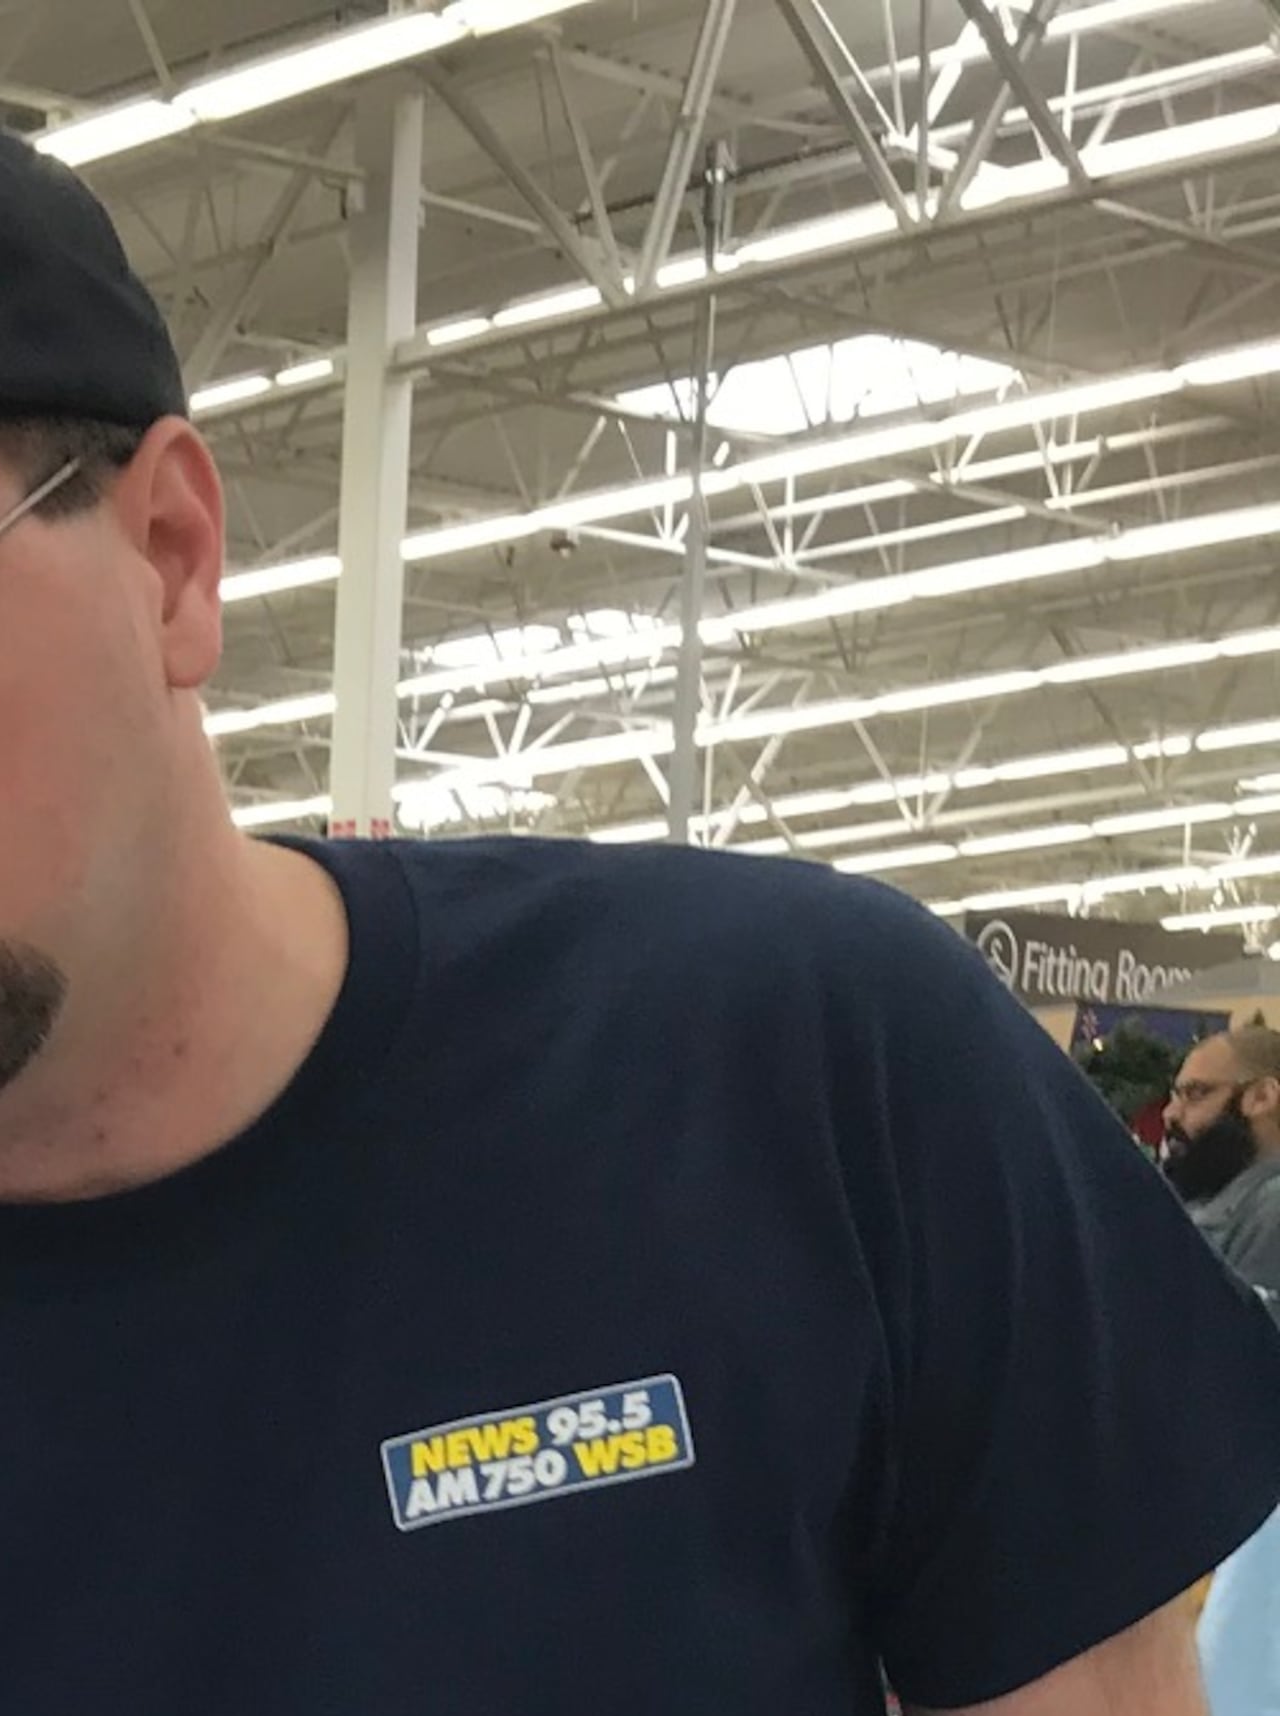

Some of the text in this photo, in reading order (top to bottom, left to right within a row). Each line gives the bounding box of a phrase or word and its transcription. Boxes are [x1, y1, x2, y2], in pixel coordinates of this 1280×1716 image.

[411, 1391, 653, 1477] NEWS 95.5
[573, 1424, 678, 1478] WSB
